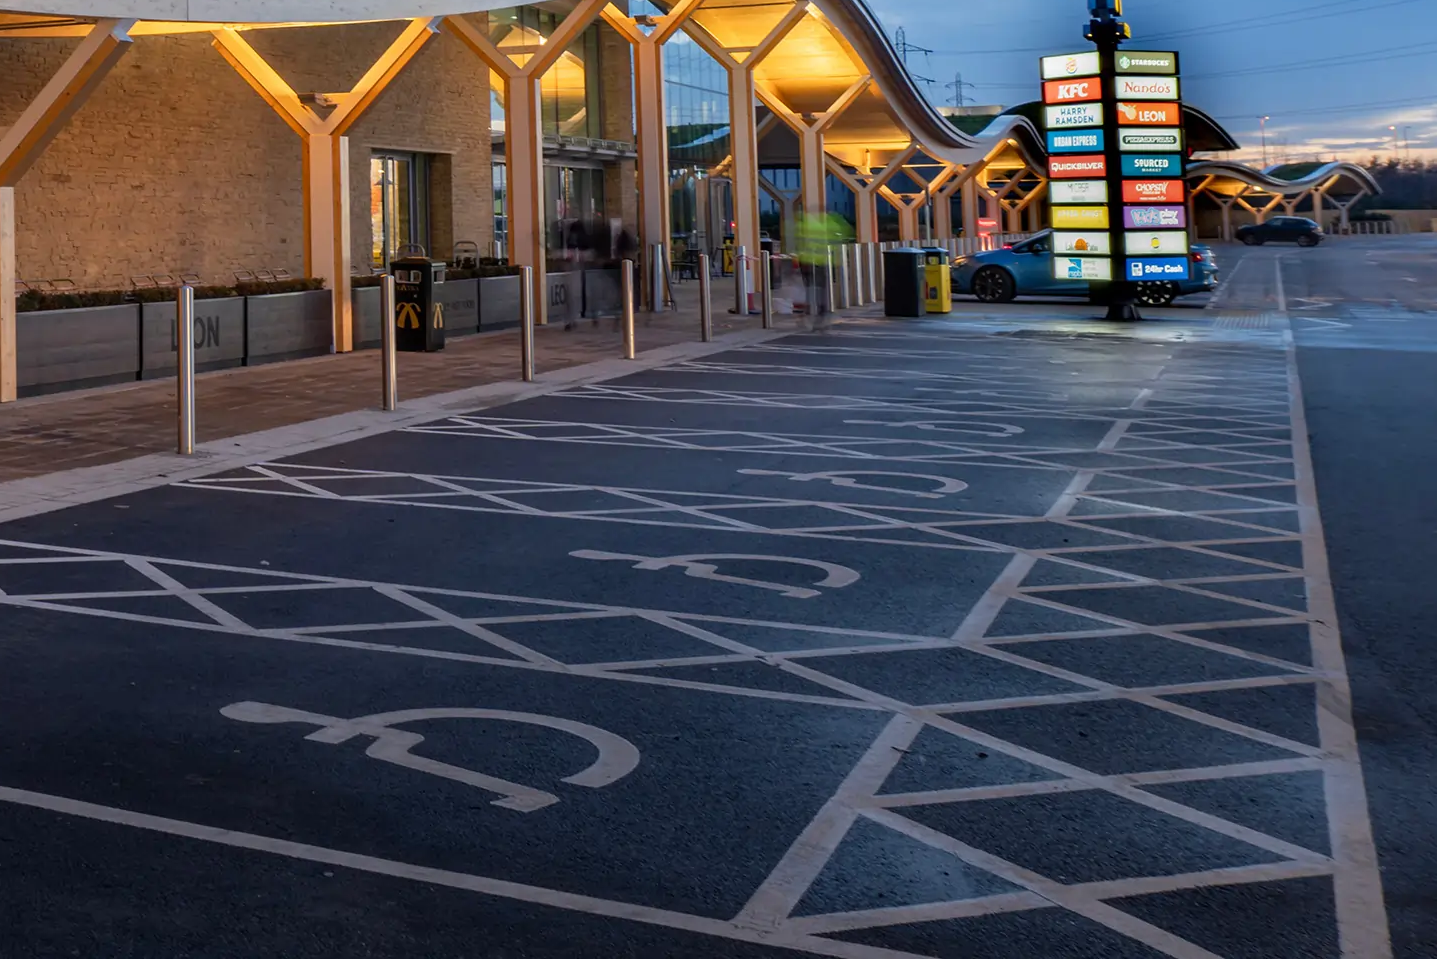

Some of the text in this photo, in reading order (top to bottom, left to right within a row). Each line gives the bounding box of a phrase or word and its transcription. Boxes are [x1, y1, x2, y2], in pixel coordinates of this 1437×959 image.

[1131, 58, 1170, 67] STARBUCKS
[1057, 83, 1088, 99] KFC
[1124, 81, 1171, 94] Nando's
[1060, 107, 1087, 116] HARRY
[1139, 111, 1166, 122] LEON
[1055, 115, 1094, 125] RAMSDEN
[1073, 135, 1097, 147] EXPRESS
[1051, 162, 1104, 172] QUICKSILVER
[1134, 158, 1169, 168] SOURCED
[1144, 264, 1184, 273] 24hr Cash
[550, 283, 572, 307] LEO
[171, 315, 220, 352] LON
